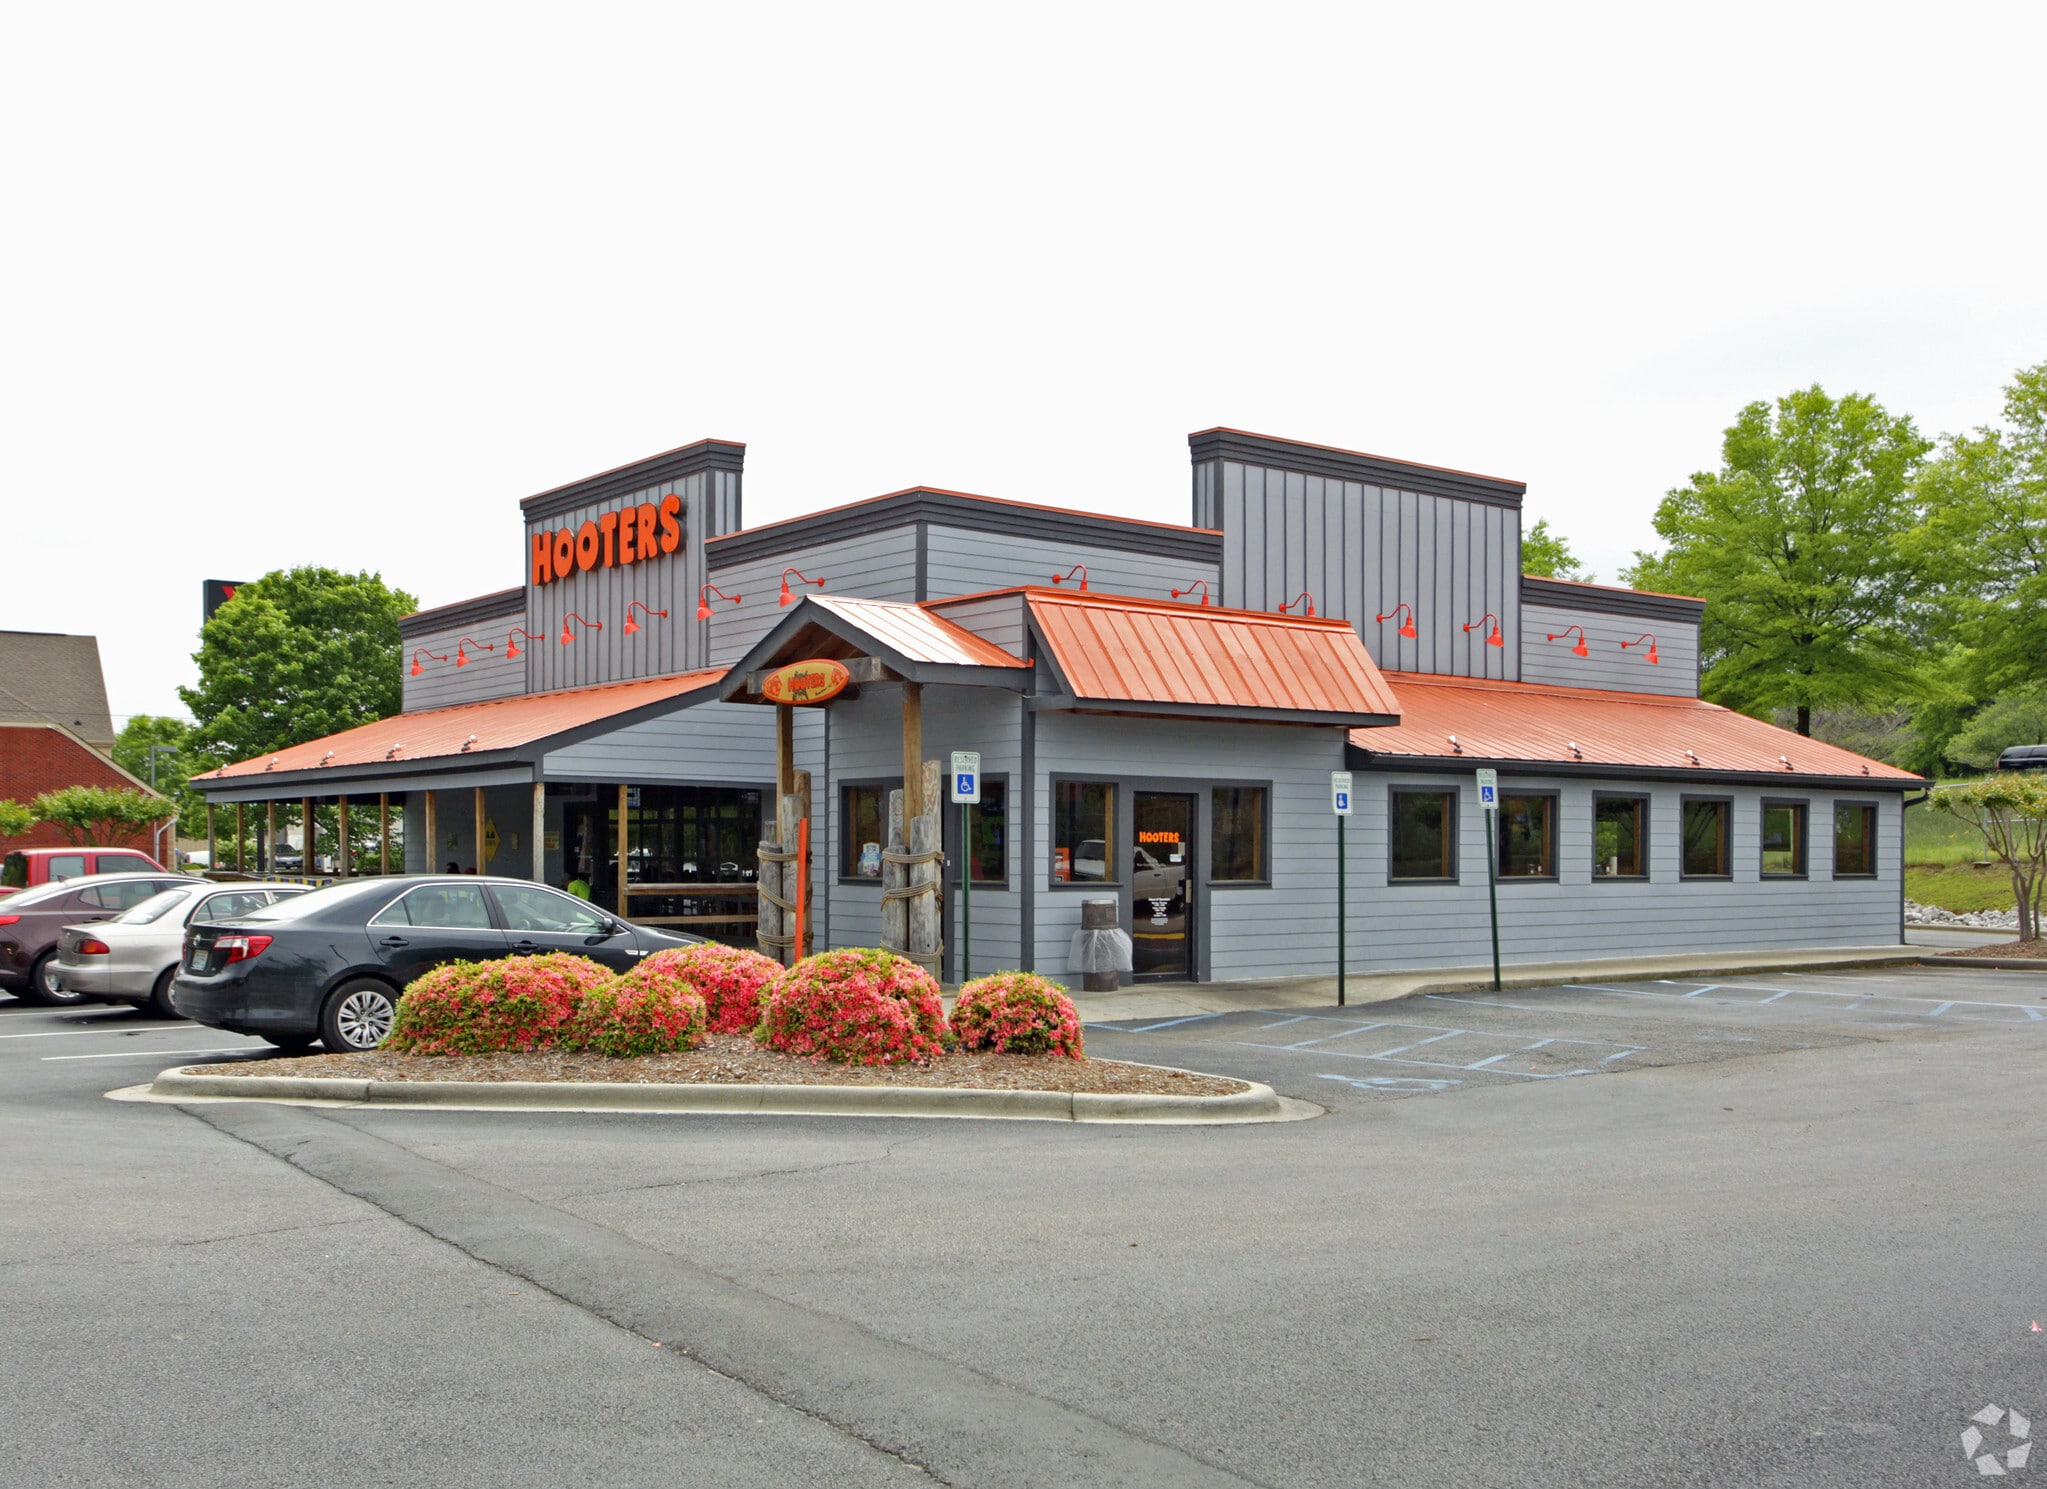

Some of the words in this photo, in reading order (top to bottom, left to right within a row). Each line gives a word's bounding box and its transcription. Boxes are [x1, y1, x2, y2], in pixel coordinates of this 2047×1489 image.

[532, 493, 682, 586] HOOTERS
[788, 673, 826, 692] HOOTERS
[953, 755, 977, 764] RESERVED
[955, 764, 975, 772] PARKING
[1139, 831, 1180, 843] HOOTERS
